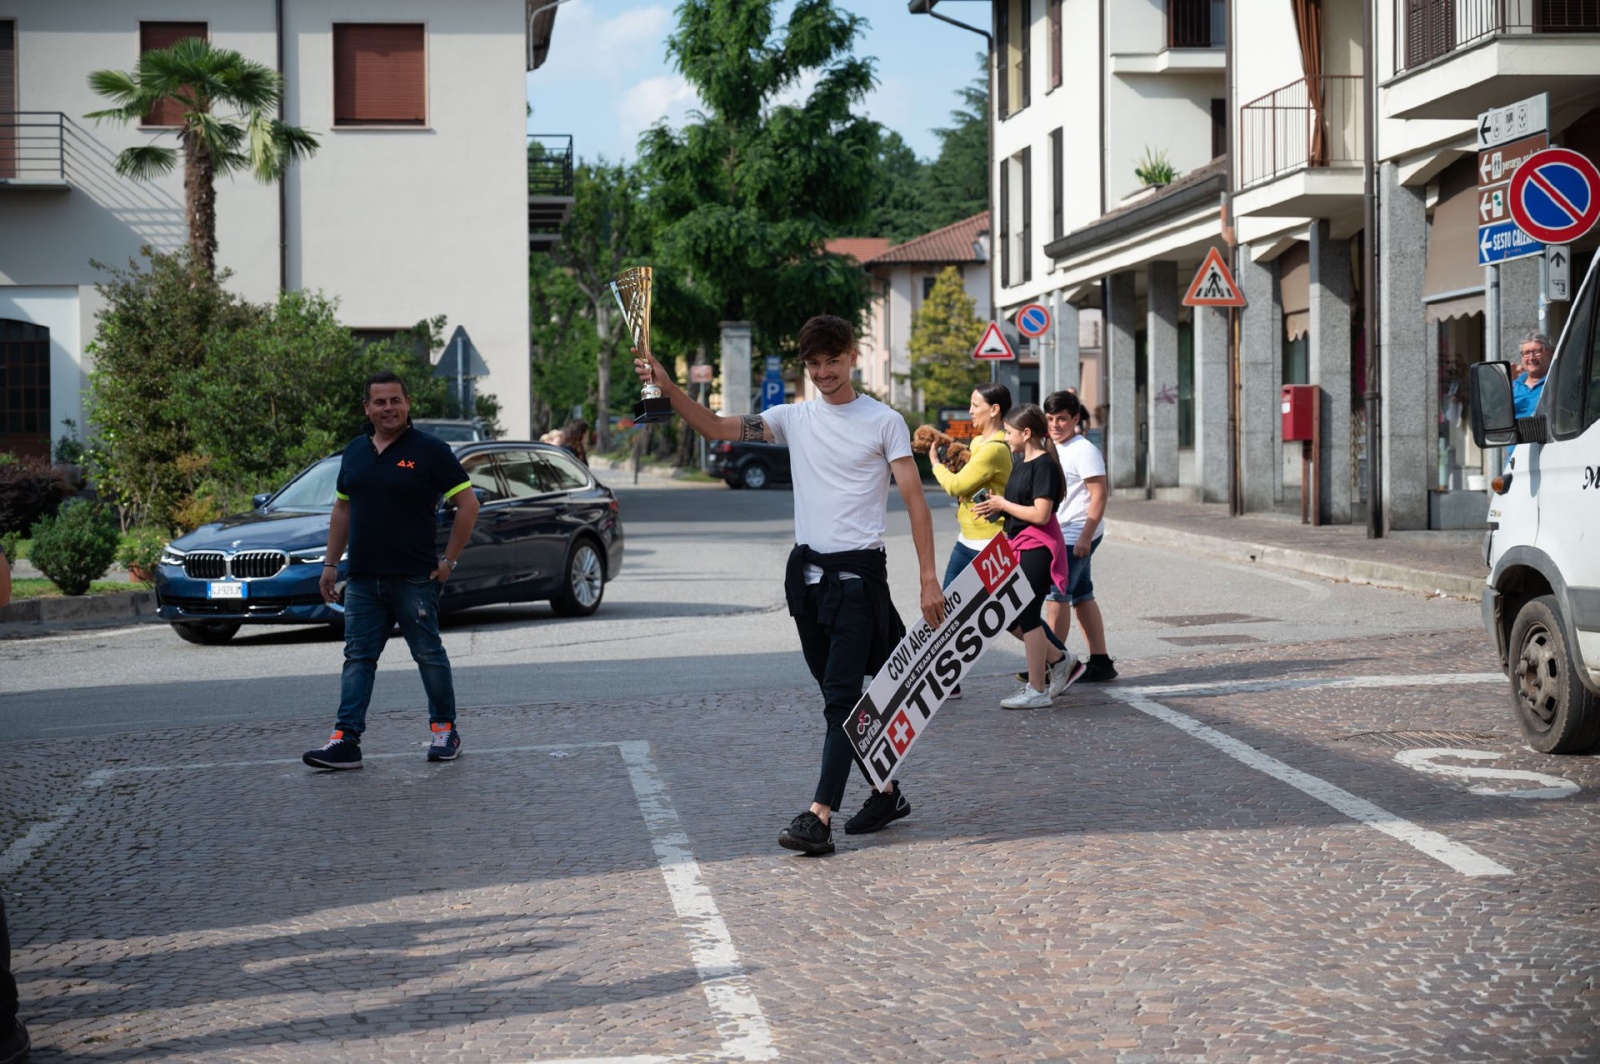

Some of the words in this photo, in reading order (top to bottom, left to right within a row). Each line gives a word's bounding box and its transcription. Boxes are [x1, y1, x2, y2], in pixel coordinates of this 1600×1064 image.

[1493, 231, 1511, 251] SESTO
[766, 382, 780, 400] P
[981, 545, 1012, 586] 214
[888, 644, 912, 681] COVI
[904, 673, 917, 688] UAE
[915, 653, 931, 674] TEAM
[930, 619, 960, 655] EMIRATES
[905, 572, 1023, 720] TISSOT
[858, 735, 871, 752] Giro
